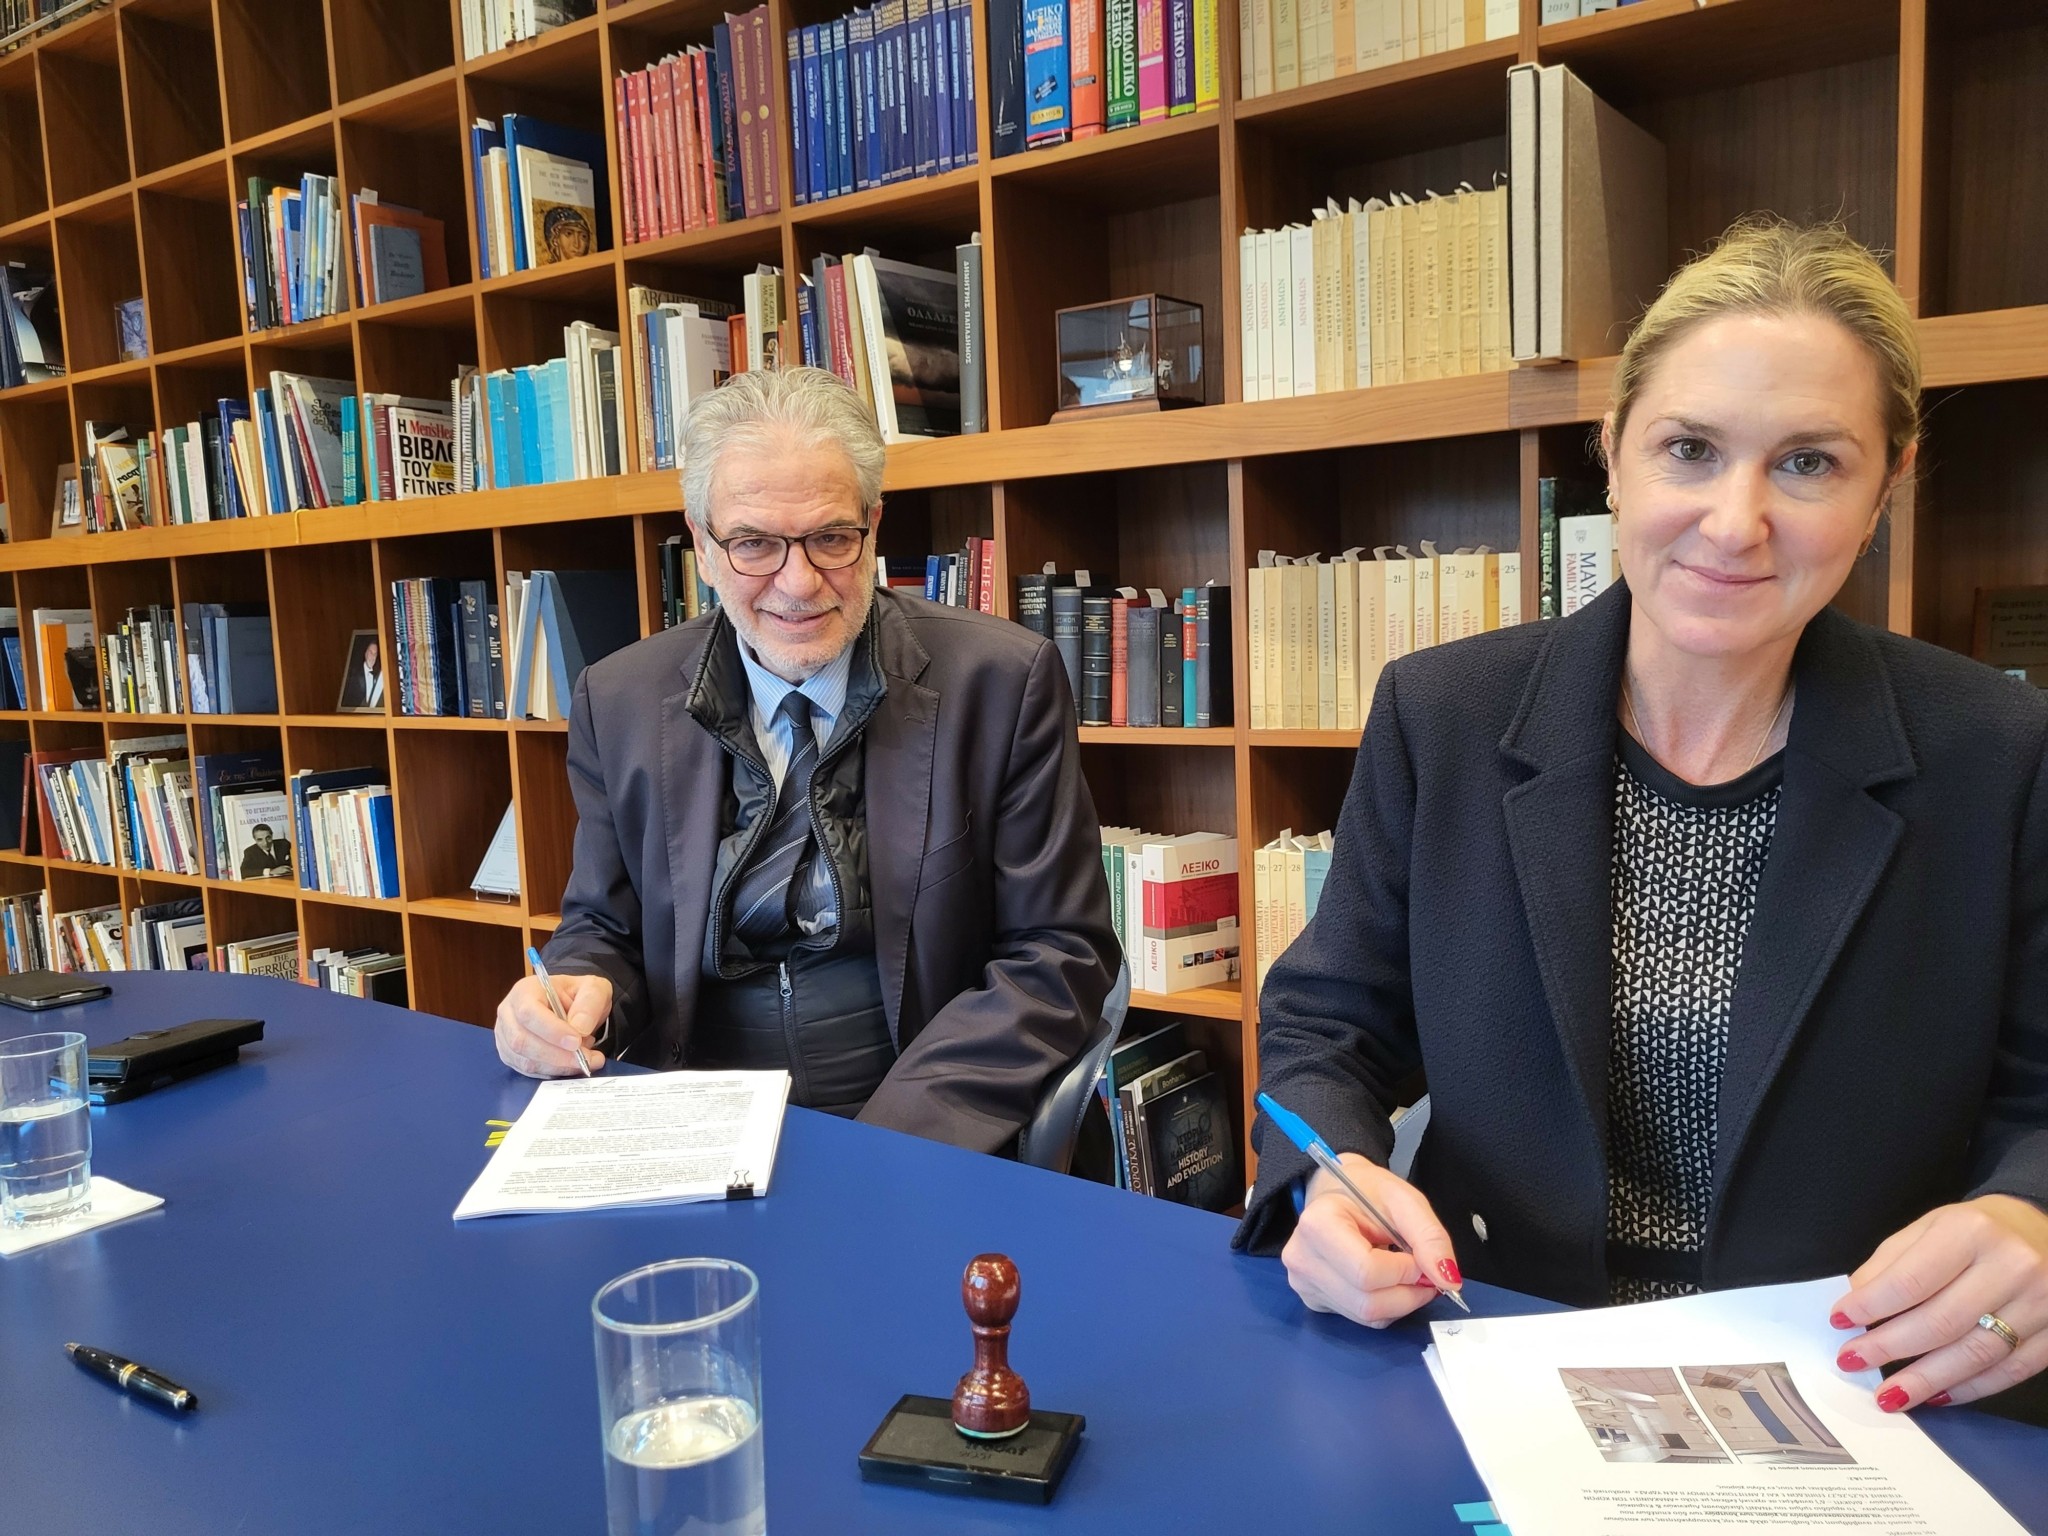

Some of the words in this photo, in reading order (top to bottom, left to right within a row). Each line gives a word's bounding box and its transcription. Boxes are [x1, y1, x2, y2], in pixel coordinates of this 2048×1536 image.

[1026, 3, 1063, 24] ΛΕΞΙΚΟ
[1547, 3, 1569, 13] 2019
[1173, 2, 1186, 57] ΛΕΞΙΚΟ
[1123, 0, 1135, 96] ΤΥΜΟΛΟΓΙΚΟ
[962, 261, 972, 308] ΔΗΜΗΤΡΗΣ
[1246, 284, 1254, 331] ΜΝΗΜΩΝ
[1278, 278, 1286, 326] ΜΝΗΜΩΝ
[1298, 277, 1307, 326] ΜΝΗΜΩΝ
[963, 310, 972, 364] ΠΑΠΑΔΗΜΟΣ
[399, 435, 454, 462] ΒΙΒΛ
[117, 467, 140, 484] racq
[401, 460, 431, 478] ΤΟΥ
[403, 479, 454, 496] FITNES
[982, 556, 991, 589] THE
[1566, 553, 1576, 592] FAMILY
[1181, 859, 1220, 874] ΛΕΞΙΚΟ
[1271, 899, 1279, 959] ΗΣΑΥΡΙΣΜΑΤΑ
[251, 957, 299, 976] PERRICO
[273, 953, 289, 962] THE
[1162, 1073, 1186, 1089] Bonhams
[1167, 1173, 1183, 1189] AND
[1183, 1153, 1223, 1180] EVOLUTION
[1178, 1146, 1208, 1170] HISTORY
